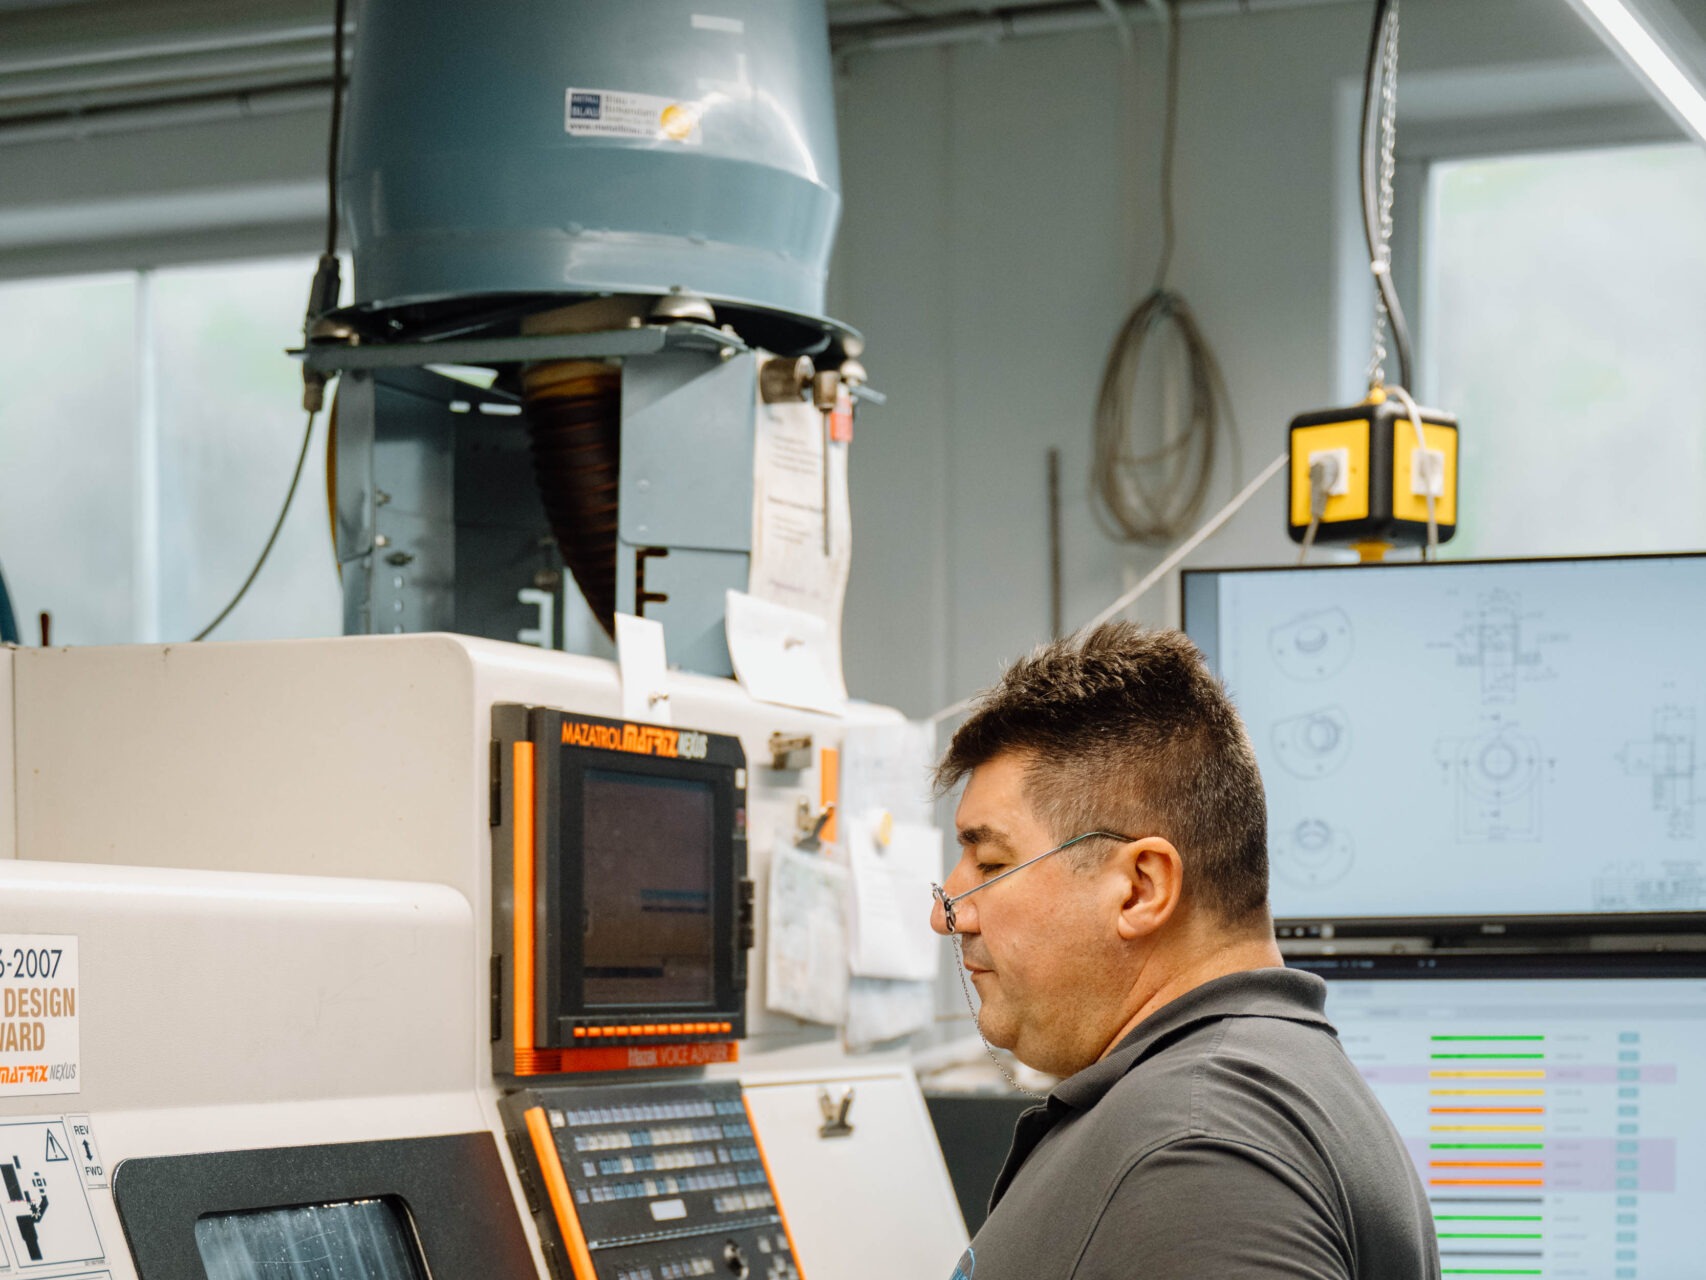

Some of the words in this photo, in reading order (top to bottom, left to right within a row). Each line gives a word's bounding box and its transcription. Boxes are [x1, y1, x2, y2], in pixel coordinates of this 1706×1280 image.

[561, 720, 623, 750] MAZATROL
[4, 987, 76, 1017] DESIGN
[50, 1062, 77, 1081] NEXUS
[73, 1125, 90, 1136] REV
[85, 1166, 104, 1177] FWD
